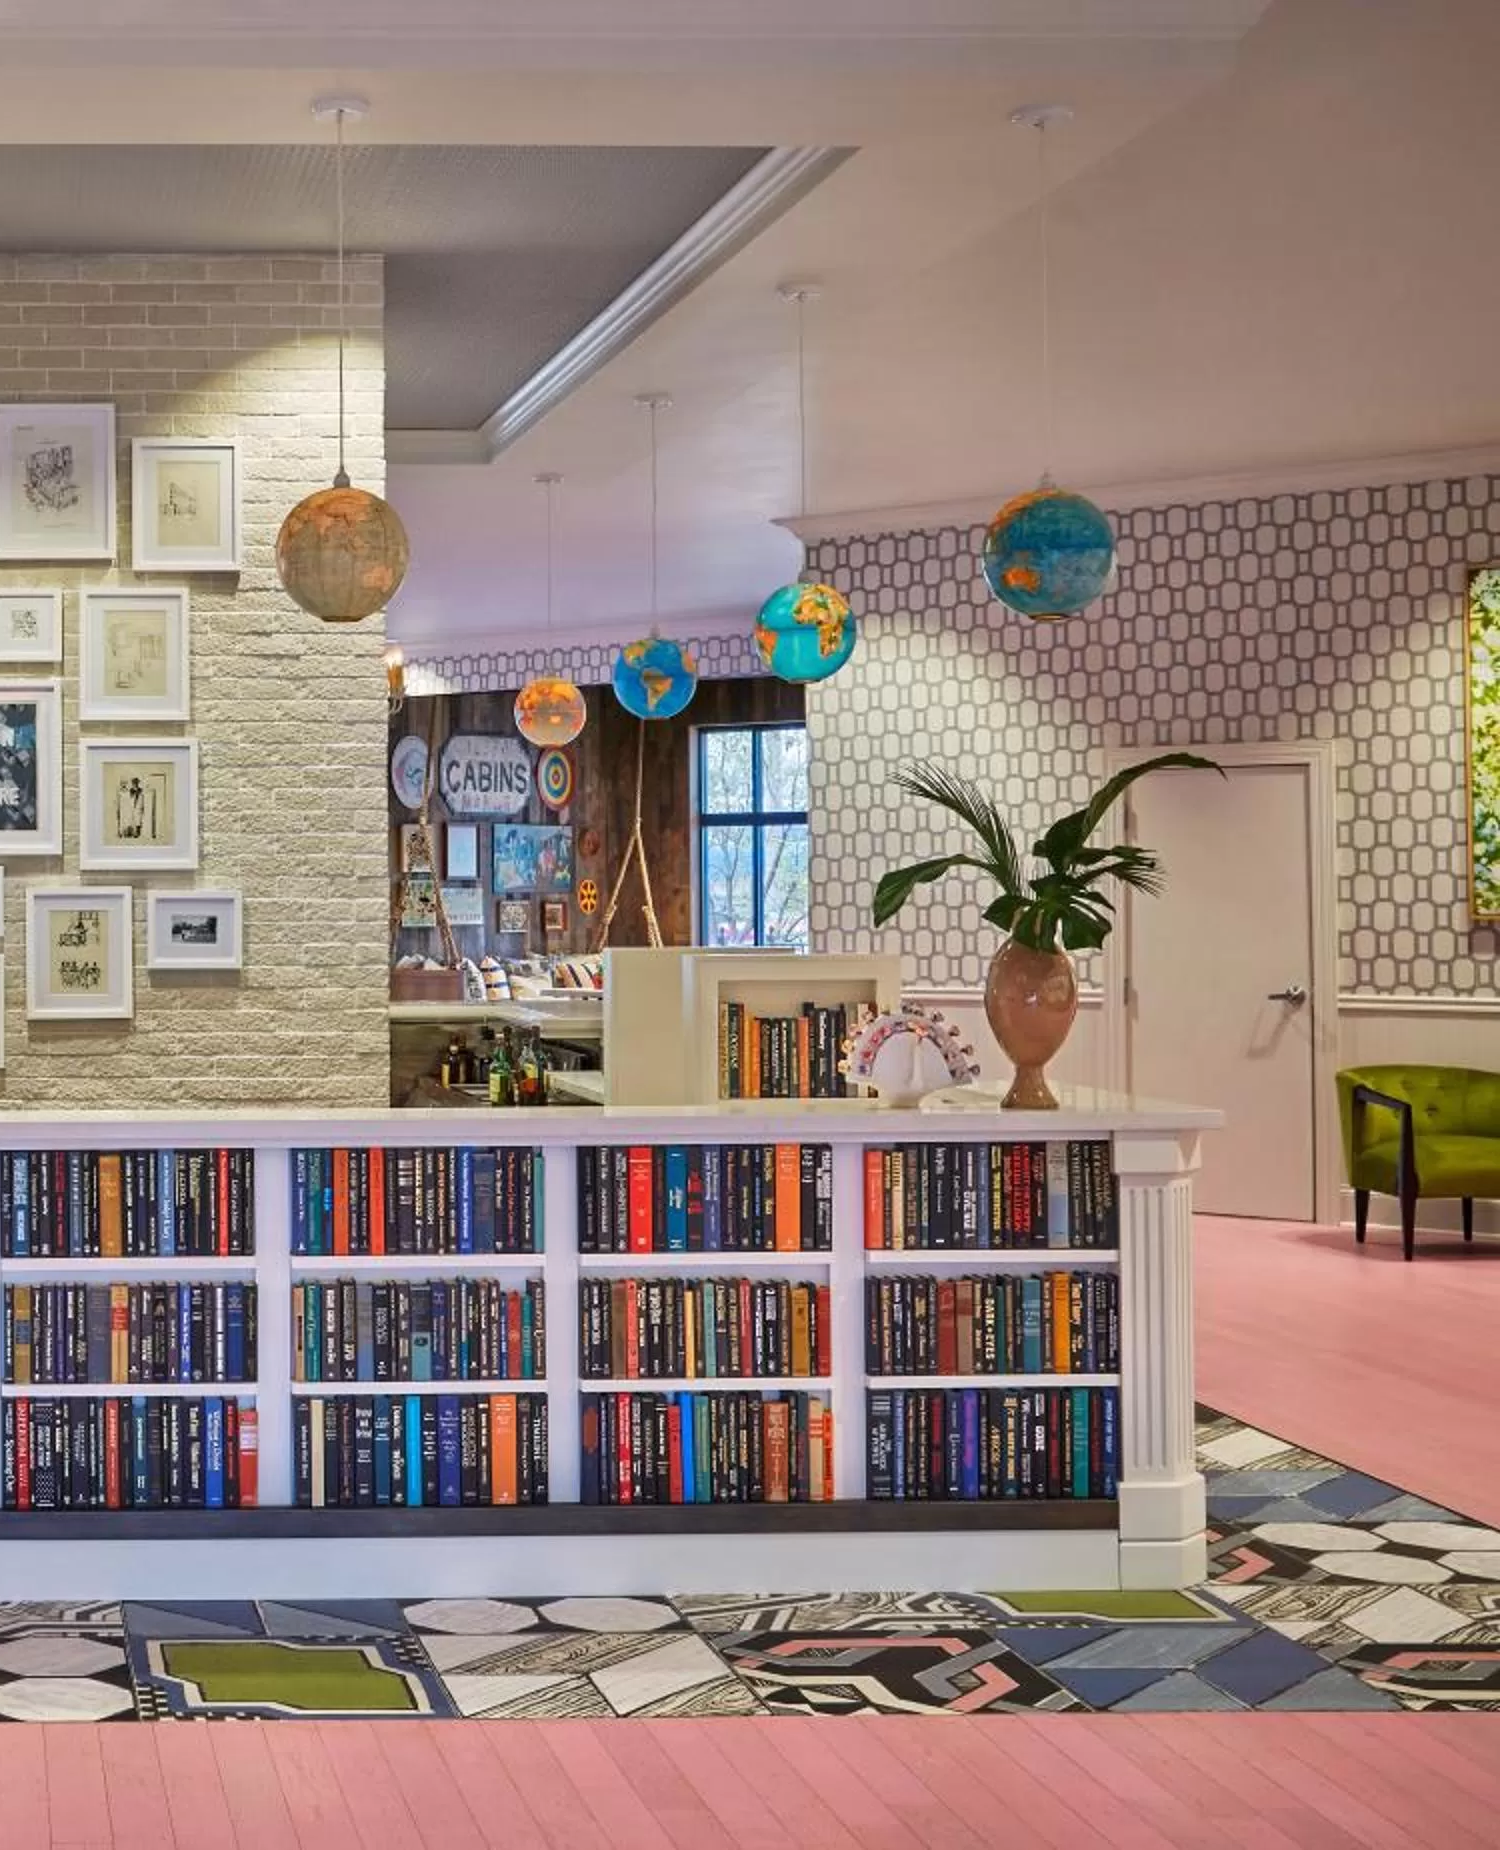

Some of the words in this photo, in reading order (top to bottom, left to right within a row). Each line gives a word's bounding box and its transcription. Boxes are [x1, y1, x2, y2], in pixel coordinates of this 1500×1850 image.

[446, 759, 528, 794] CABINS
[985, 1298, 995, 1326] DARK
[985, 1333, 995, 1360] EYES
